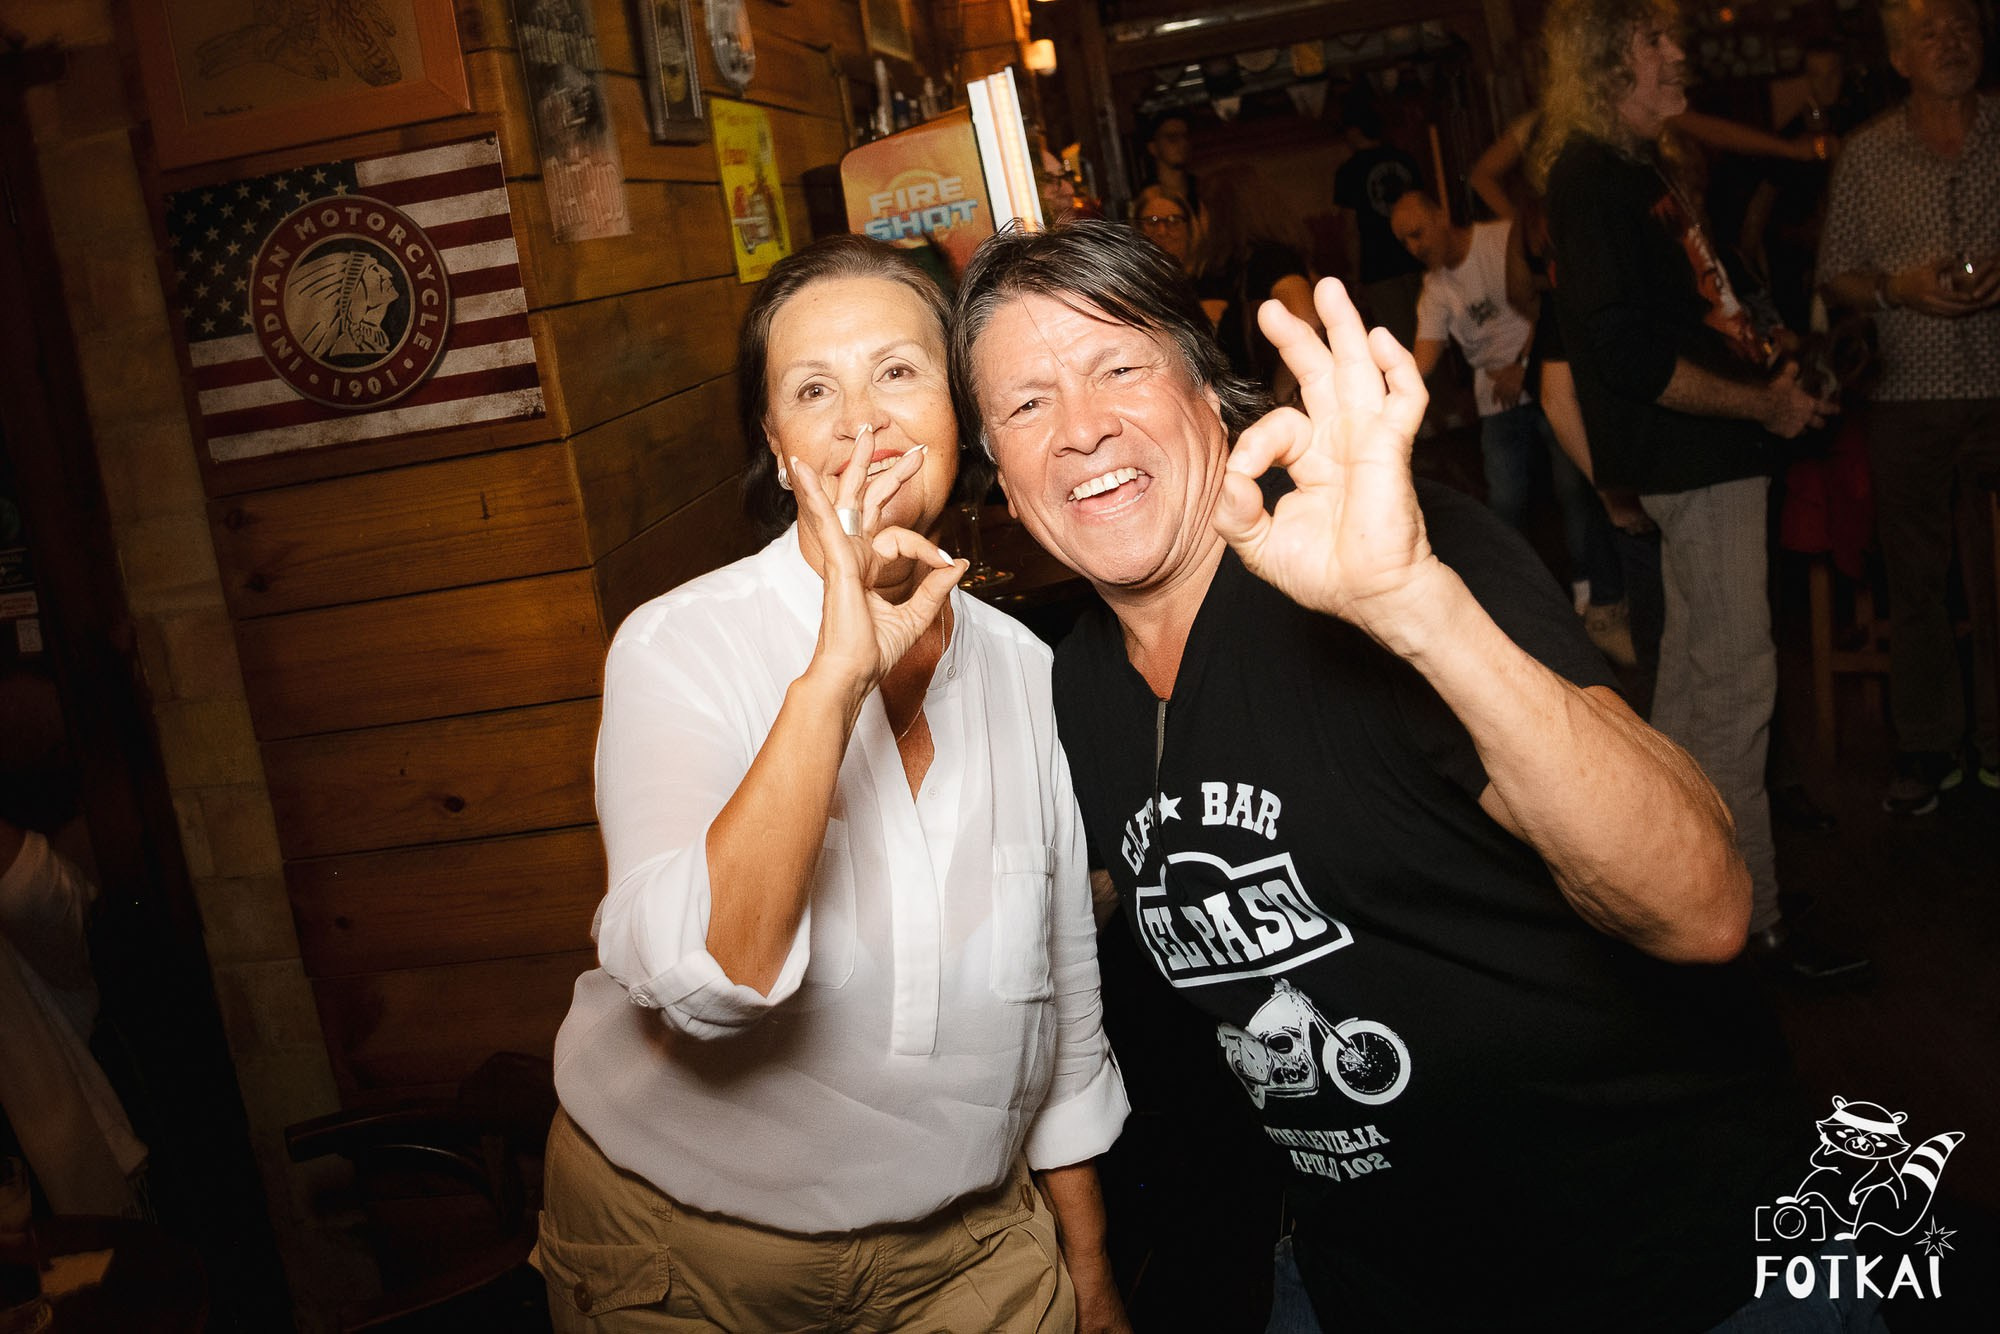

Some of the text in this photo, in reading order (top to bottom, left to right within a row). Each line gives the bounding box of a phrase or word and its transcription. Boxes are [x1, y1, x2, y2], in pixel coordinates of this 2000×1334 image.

[867, 176, 965, 216] FIRE
[864, 199, 978, 241] SHOT
[260, 207, 440, 372] INDIAN MOTORCYCLE
[332, 369, 399, 397] 1901
[1201, 781, 1282, 840] BAR
[1264, 1124, 1391, 1154] TORREVIEJA
[1289, 1149, 1392, 1182] APOLO 102
